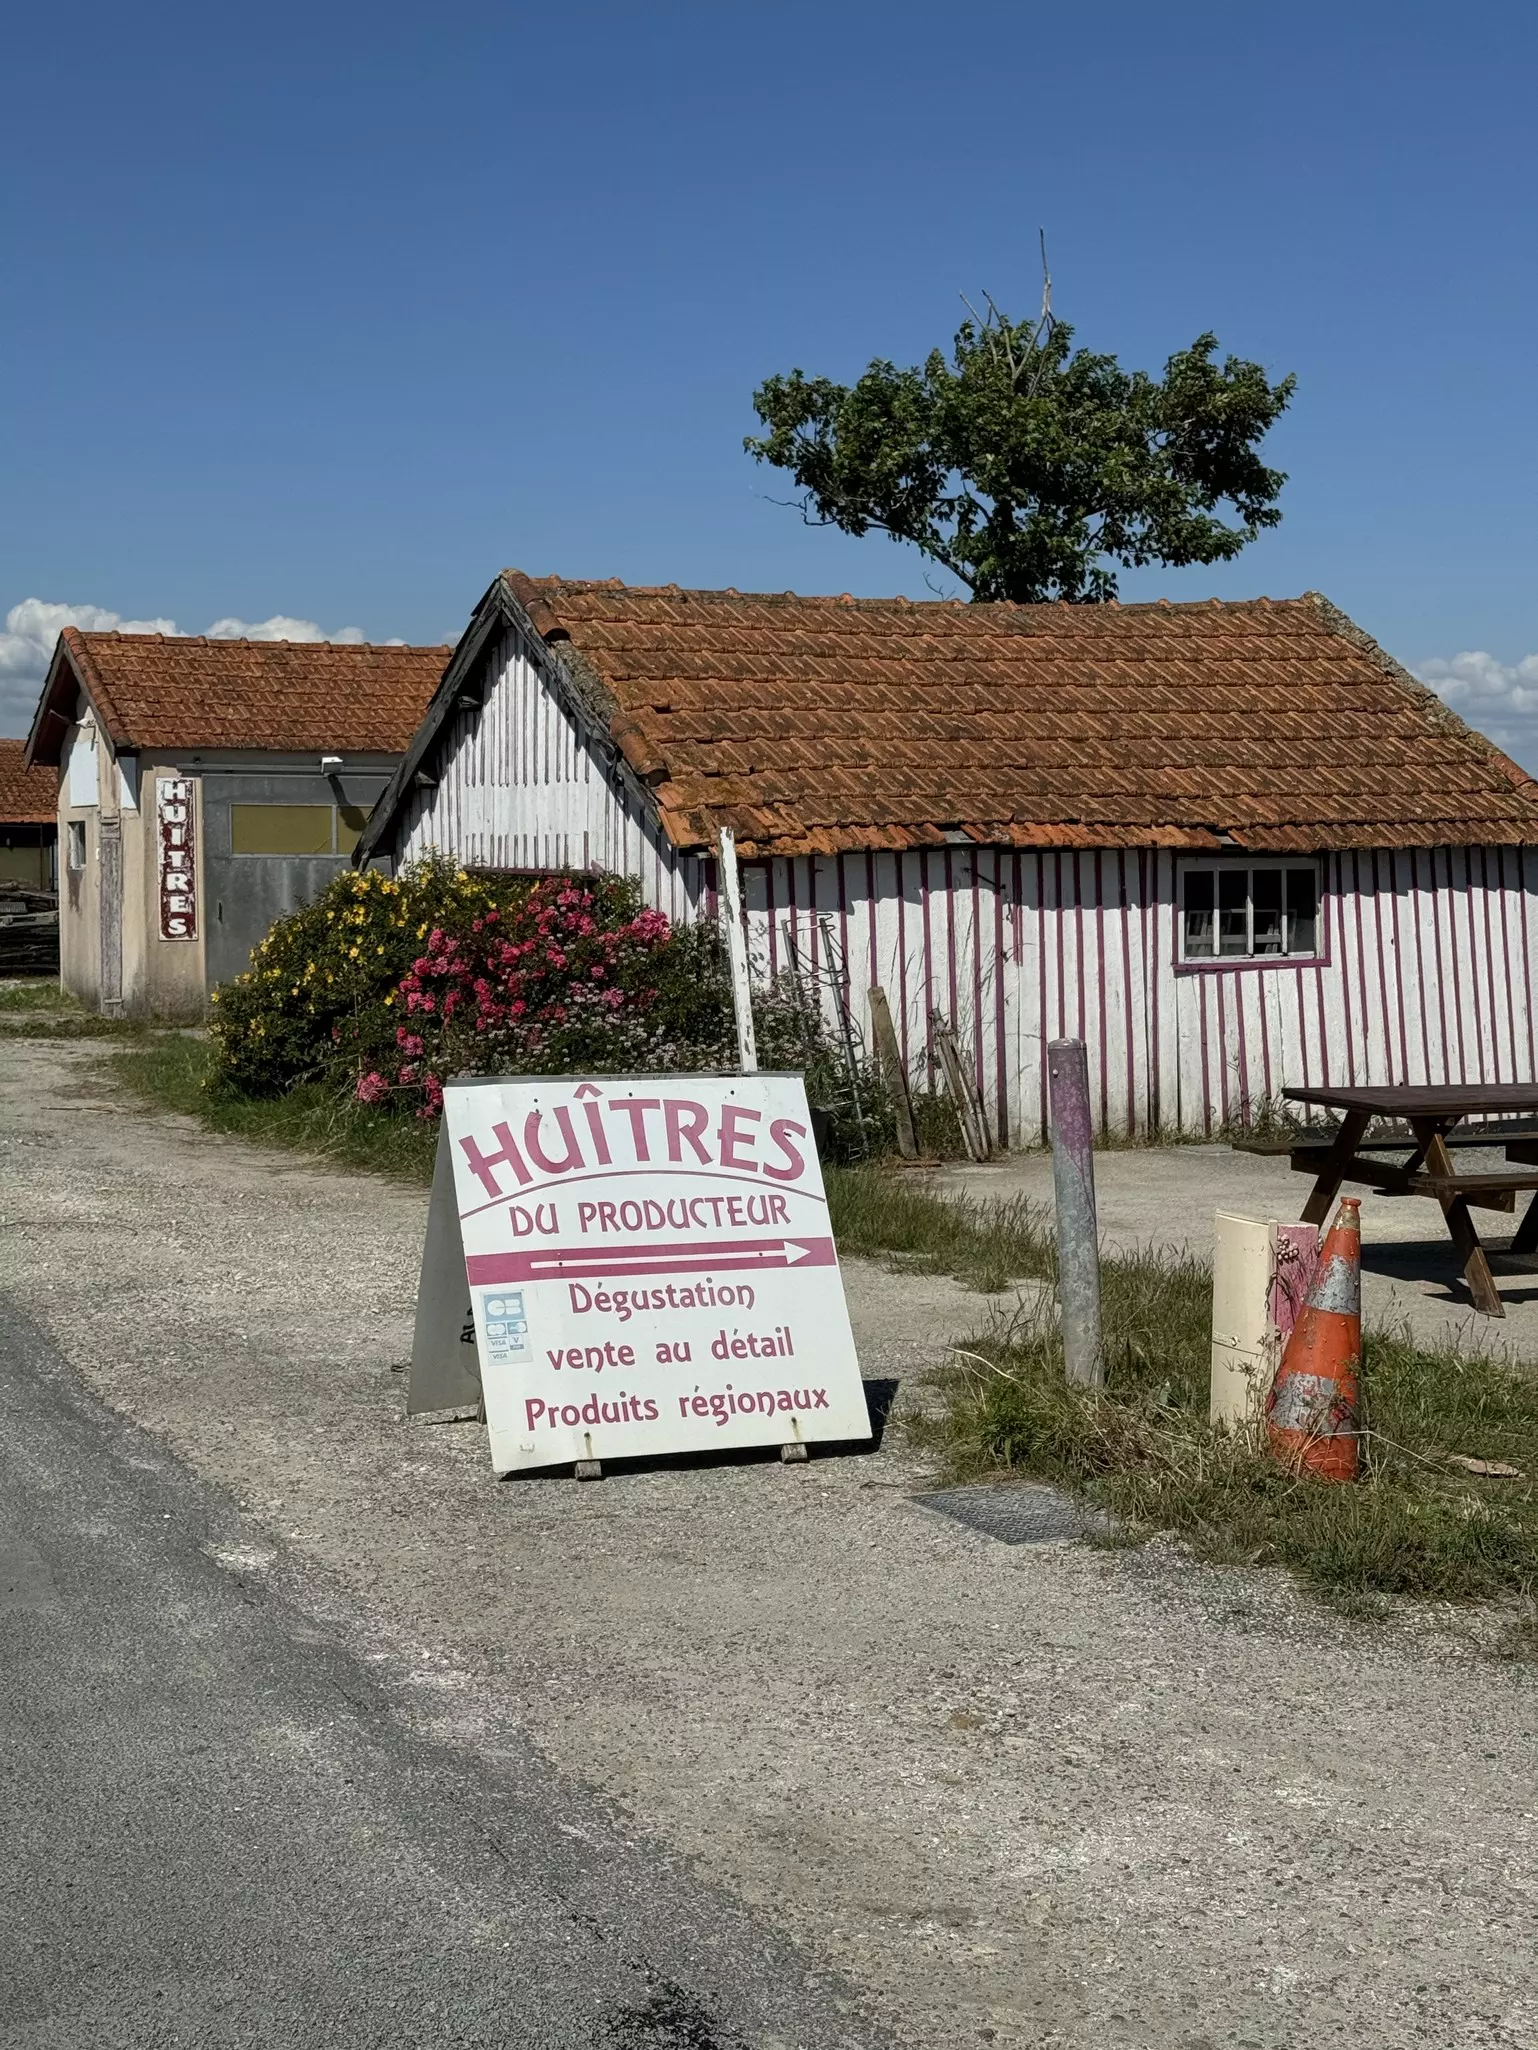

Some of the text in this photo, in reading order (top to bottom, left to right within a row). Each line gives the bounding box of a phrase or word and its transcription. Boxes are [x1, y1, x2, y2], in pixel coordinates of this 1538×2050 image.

[163, 782, 189, 935] HUITRES
[458, 1083, 807, 1199] HUÎTRES
[510, 1194, 792, 1237] DU PRODUCTEUR
[568, 1277, 756, 1321] Dégustation
[491, 1339, 507, 1347] VISA
[547, 1326, 795, 1373] vente au détail
[525, 1384, 830, 1431] Produits régionaux
